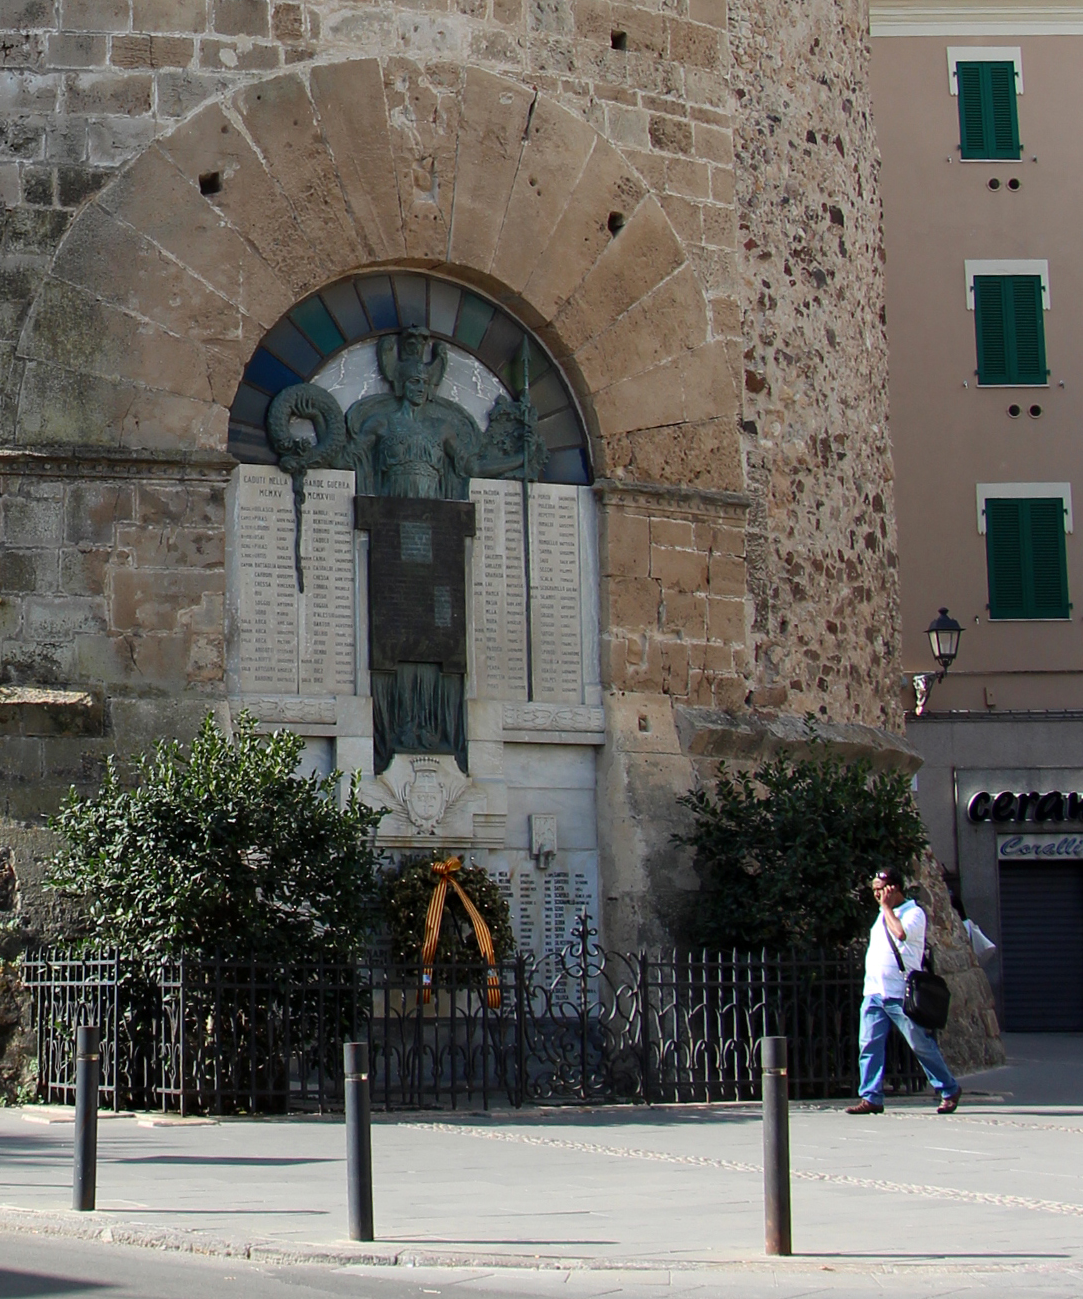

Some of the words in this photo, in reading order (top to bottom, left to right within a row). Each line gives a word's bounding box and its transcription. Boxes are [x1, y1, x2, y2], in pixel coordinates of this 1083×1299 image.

[243, 475, 265, 484] CADUTI
[269, 476, 288, 486] NELLA
[304, 478, 324, 488] RANDE
[327, 480, 350, 489] GUERRA
[259, 489, 282, 498] MCMXV
